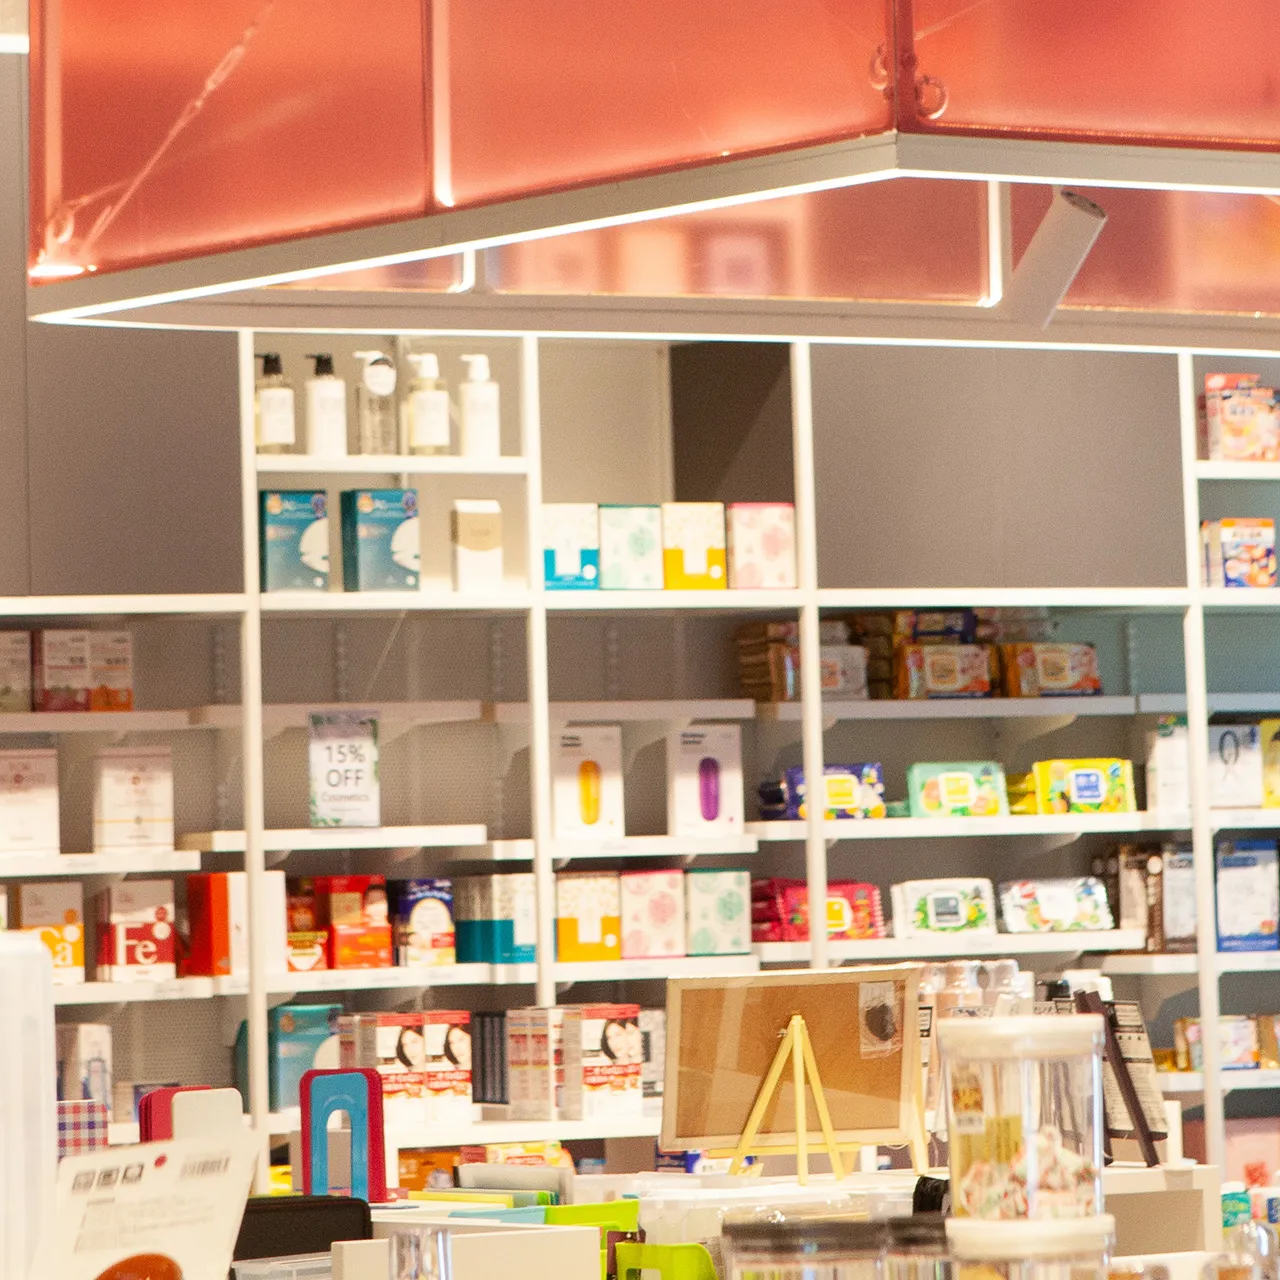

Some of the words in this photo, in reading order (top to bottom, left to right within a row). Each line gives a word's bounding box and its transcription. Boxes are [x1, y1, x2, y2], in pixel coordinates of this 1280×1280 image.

[325, 743, 366, 763] 15%
[326, 768, 364, 788] OFF
[116, 922, 158, 965] Fe
